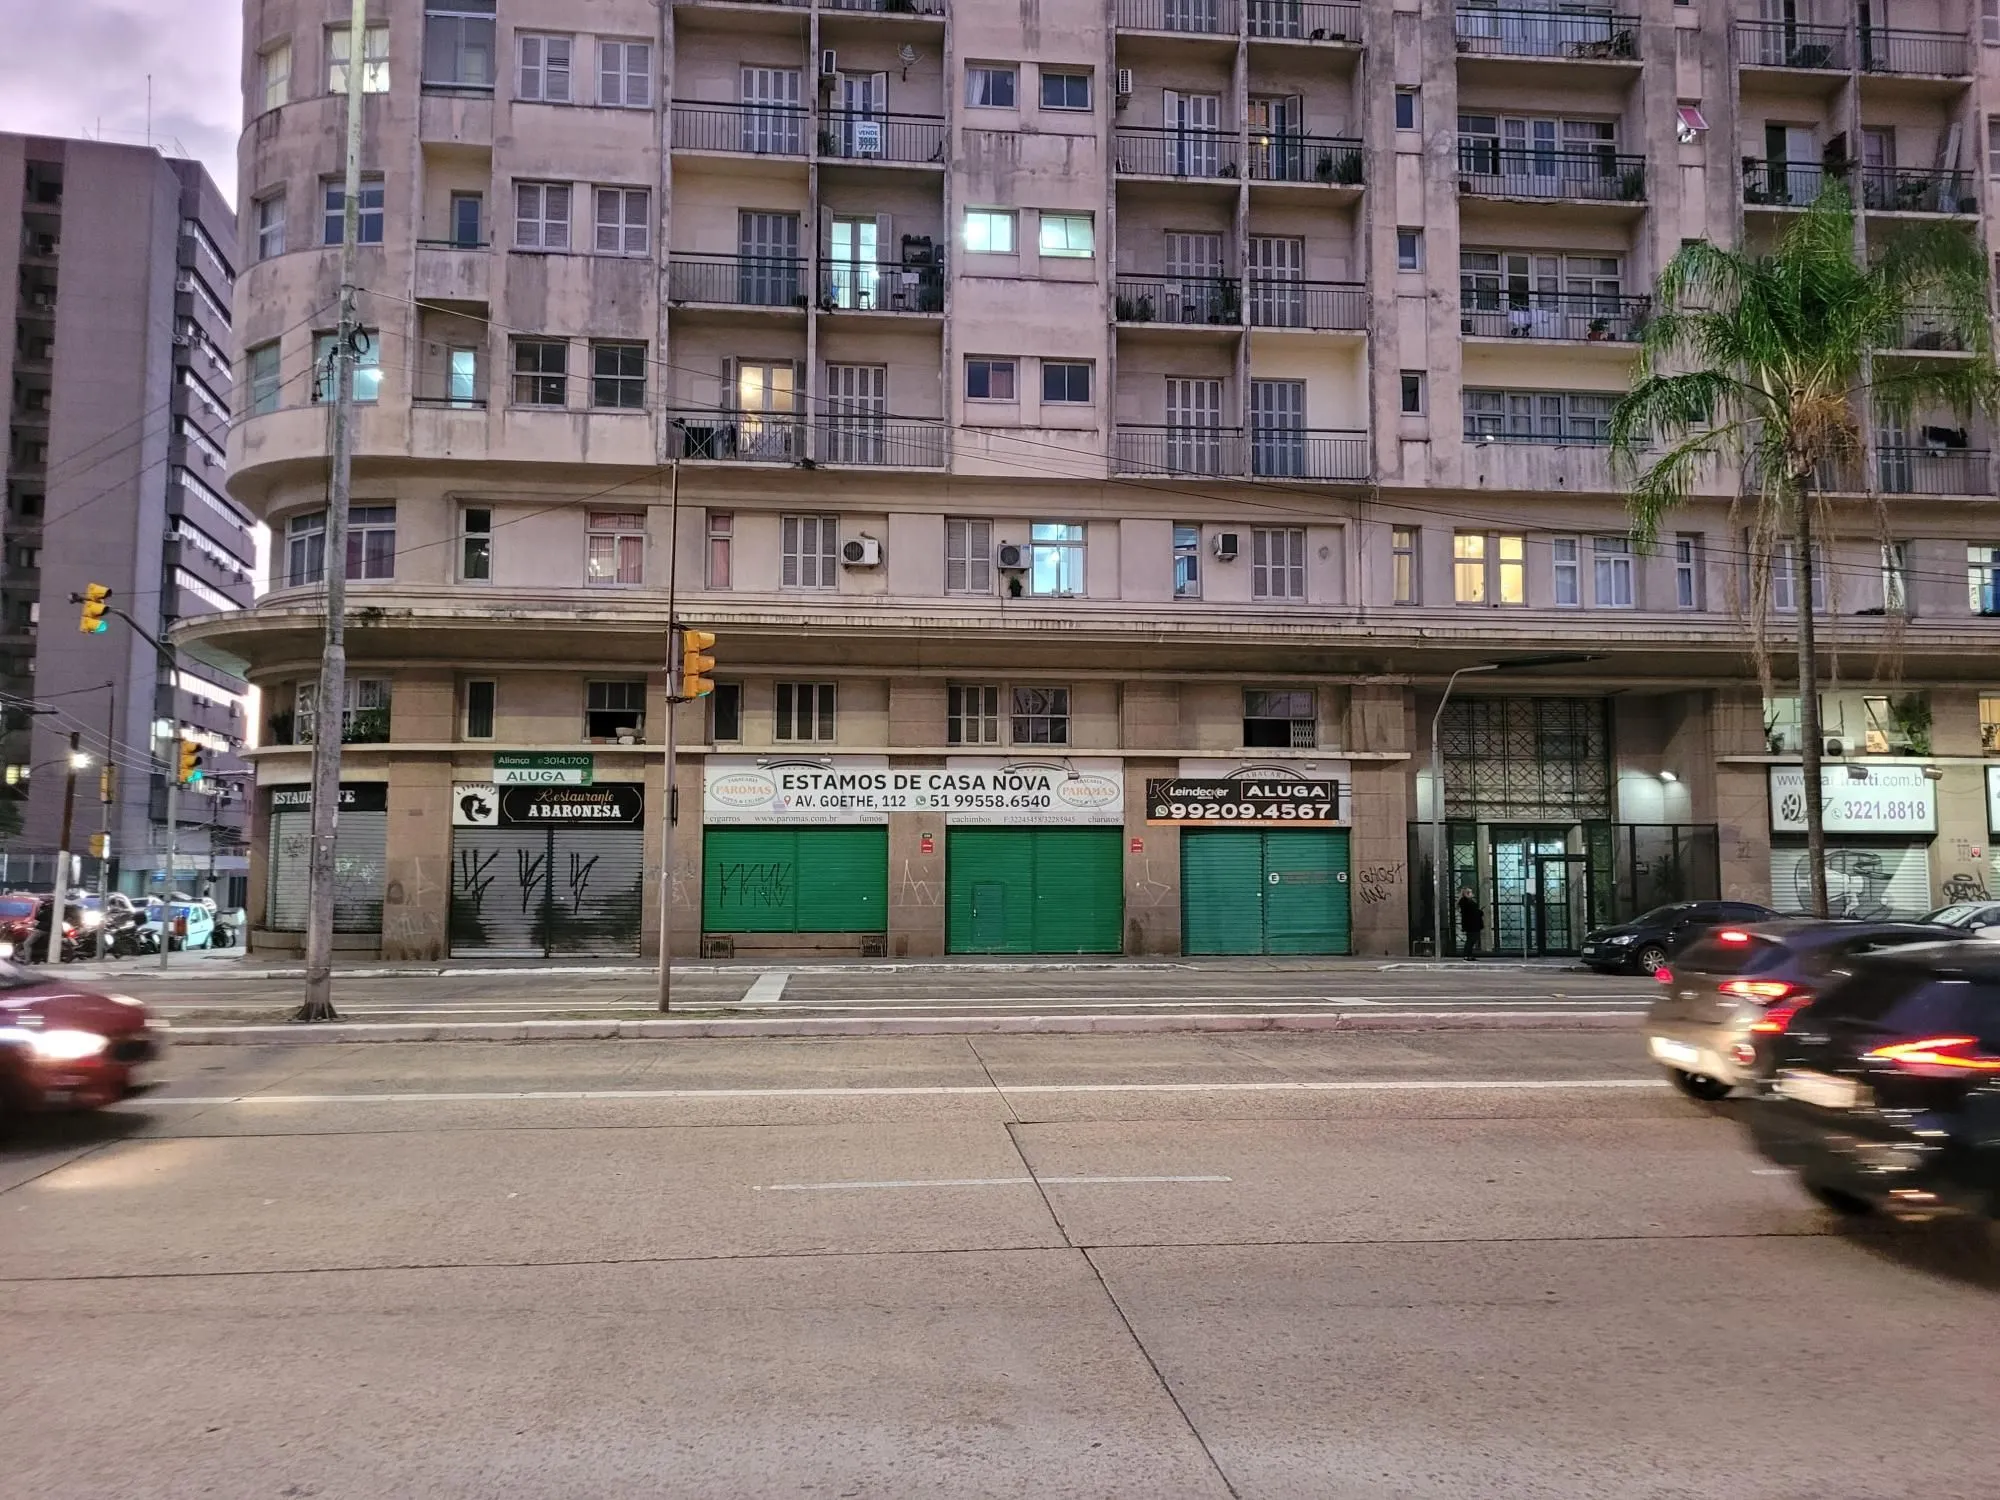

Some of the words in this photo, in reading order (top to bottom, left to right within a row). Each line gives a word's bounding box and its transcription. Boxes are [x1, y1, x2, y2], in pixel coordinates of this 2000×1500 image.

[543, 756, 590, 765] 3014.1700
[506, 771, 566, 782] ALUGA
[782, 774, 887, 790] ESTAMOS
[894, 774, 922, 790] DE
[928, 775, 986, 790] CASA
[992, 775, 1051, 791] NOVA
[535, 788, 614, 805] Restaurante
[716, 785, 773, 795] PAROMAS
[1062, 786, 1115, 797] PAROMAS
[1169, 786, 1229, 799] Leindecker
[1246, 785, 1326, 798] ALUGA
[795, 795, 816, 808] AV.
[820, 795, 878, 810] GOETHE,
[882, 795, 906, 807] 112
[930, 794, 950, 808] 51
[954, 794, 1051, 808] 99558.6540
[528, 804, 539, 817] A
[540, 804, 622, 818] BARONESA
[1169, 803, 1331, 819] 99209.4567
[1844, 801, 1926, 819] 3221.8818
[709, 815, 741, 823] cigarros
[754, 815, 837, 823] www.paromas.com.br
[859, 815, 883, 823] fumos
[951, 815, 992, 824] cachimbos
